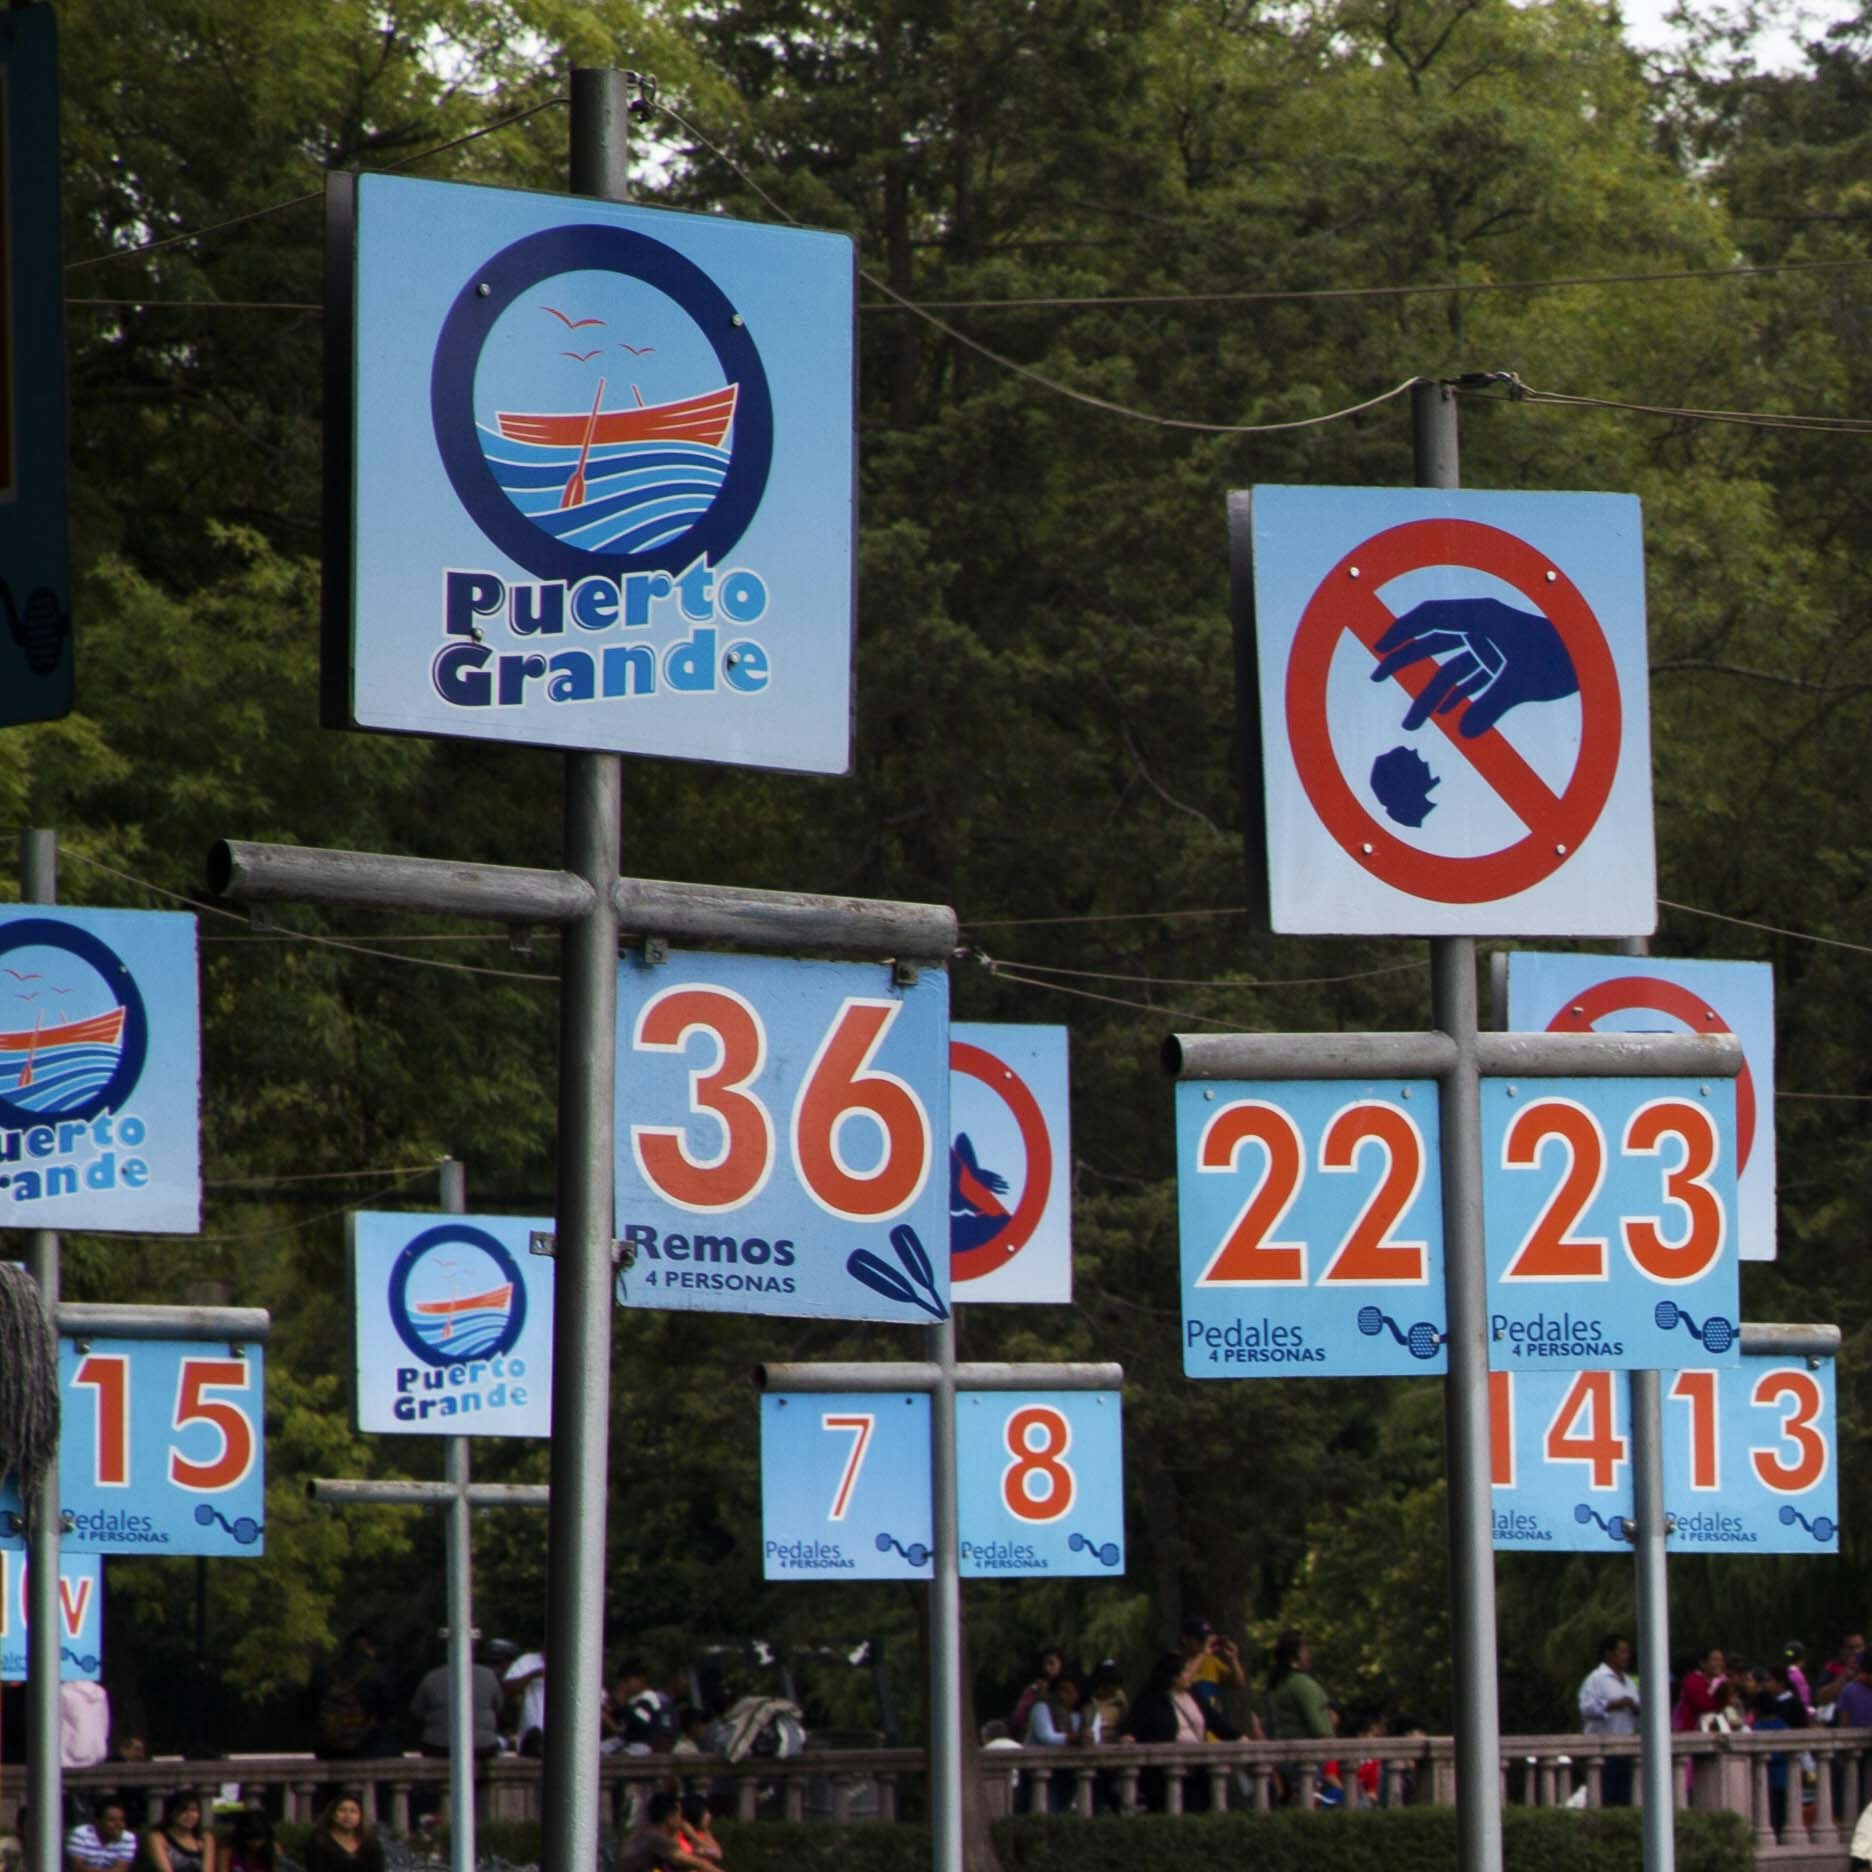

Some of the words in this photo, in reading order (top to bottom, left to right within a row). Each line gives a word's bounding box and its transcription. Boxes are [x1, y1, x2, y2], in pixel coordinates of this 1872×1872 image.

[443, 550, 769, 637] Puerto
[432, 626, 770, 707] Grande
[631, 983, 932, 1223] 36
[0, 1107, 147, 1162] uerto
[1194, 1099, 1430, 1287] 22
[1498, 1096, 1727, 1286] 23
[624, 1223, 796, 1267] Remos
[645, 1271, 657, 1287] 4
[666, 1270, 796, 1293] PERSONAS
[1187, 1316, 1303, 1350] Pedales
[1492, 1313, 1602, 1343] Pedales
[1209, 1349, 1219, 1363] 4
[1224, 1348, 1326, 1363] PERSONAS
[1512, 1344, 1521, 1357] 4
[1527, 1343, 1624, 1357] PERSONAS
[396, 1351, 527, 1393] Puerto
[393, 1383, 528, 1421] Grande
[70, 1354, 256, 1493] 15
[1668, 1367, 1829, 1495] 13
[822, 1413, 875, 1521] 7
[1003, 1404, 1077, 1524] 8
[78, 1532, 85, 1541] 4
[90, 1532, 168, 1543] PERSONAS
[765, 1537, 841, 1559] Pedales
[961, 1538, 1035, 1560] Pedales
[1492, 1530, 1552, 1541] ERSONAS
[1680, 1532, 1687, 1541] 4
[1690, 1532, 1757, 1543] PERSONAS
[781, 1559, 788, 1568] 4
[790, 1559, 855, 1569] PERSONAS
[976, 1559, 982, 1568] 4
[984, 1559, 1049, 1569] PERSONAS
